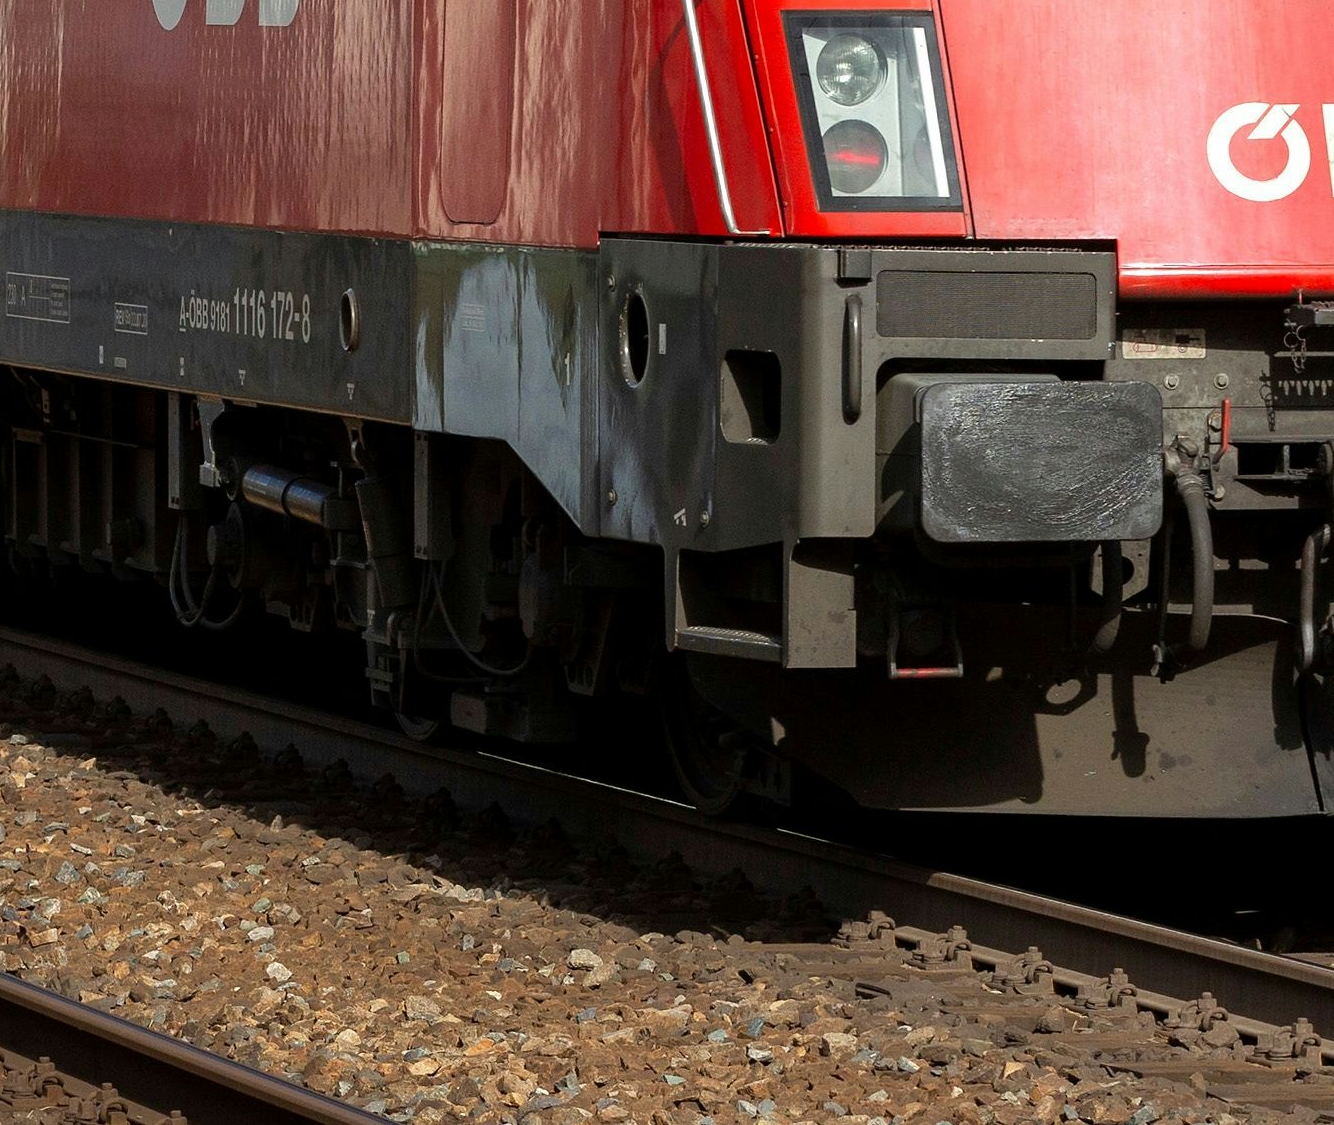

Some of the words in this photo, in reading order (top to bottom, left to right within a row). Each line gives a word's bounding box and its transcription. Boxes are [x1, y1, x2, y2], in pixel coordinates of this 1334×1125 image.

[179, 289, 209, 331] A-ÖBB
[211, 300, 230, 332] 9181
[234, 287, 266, 338] 1116
[271, 291, 311, 343] 172-8
